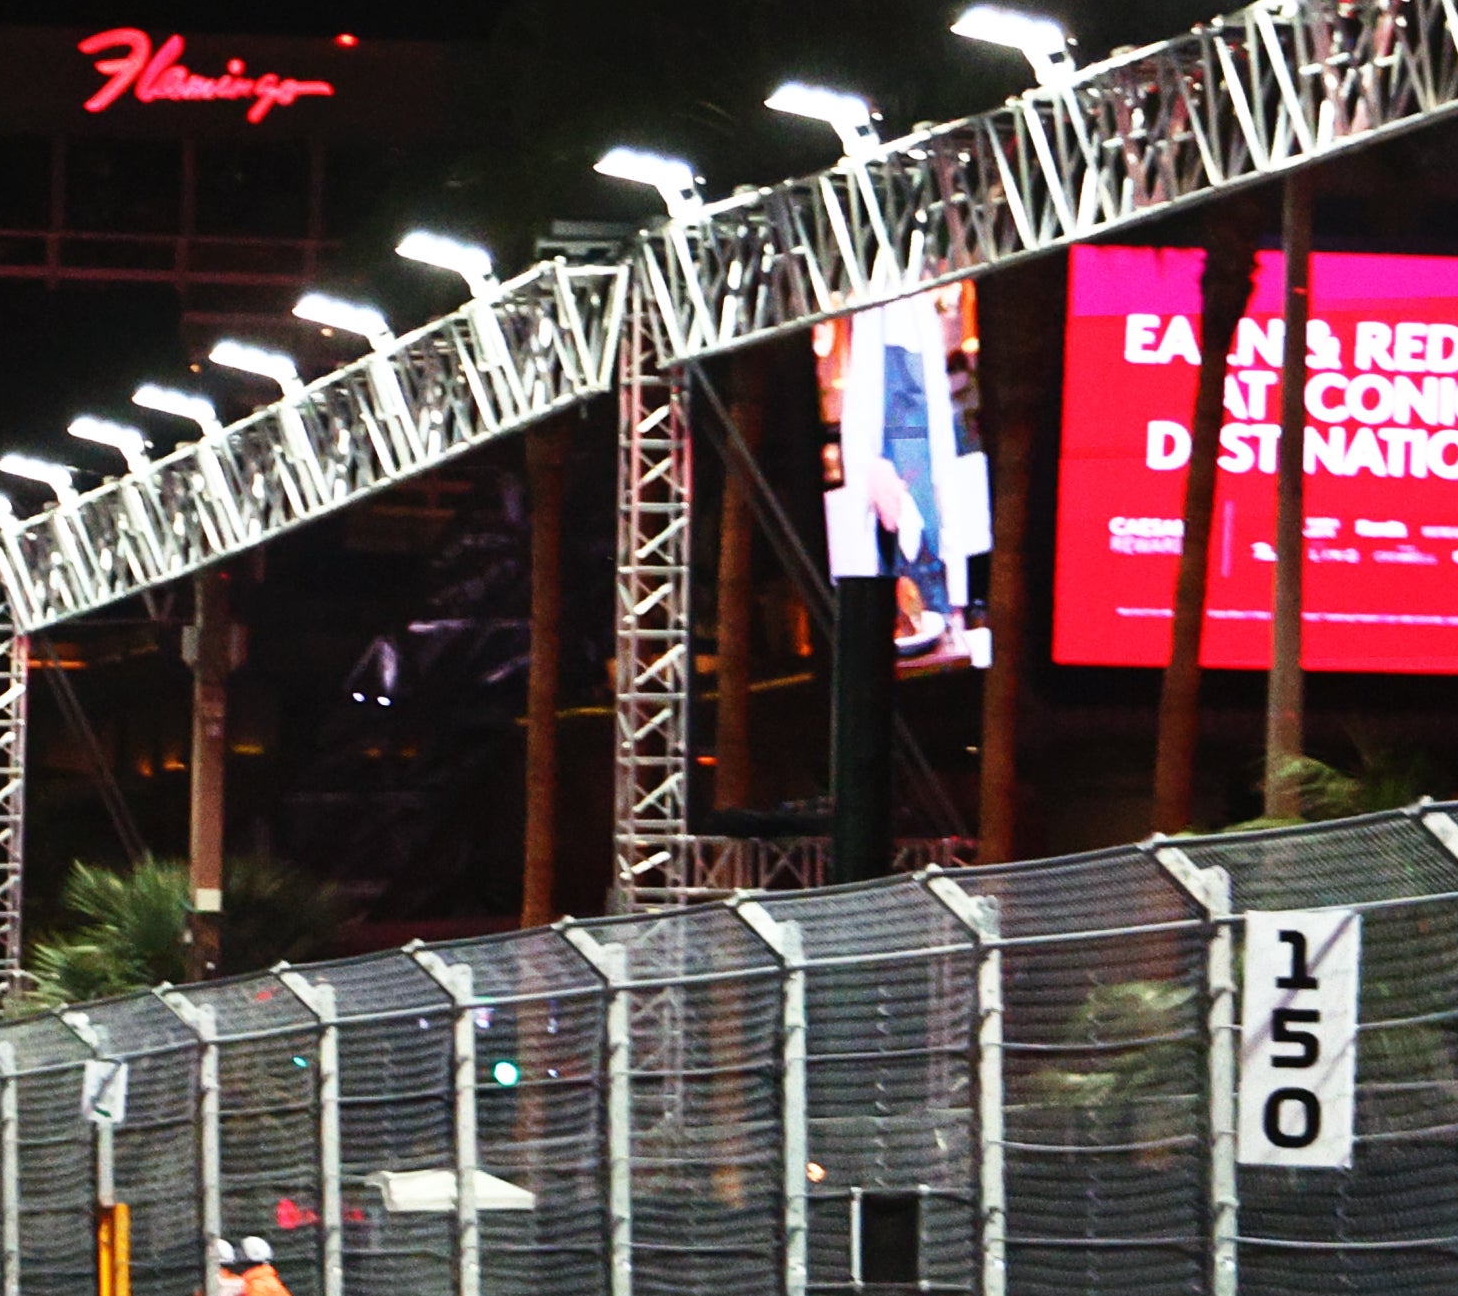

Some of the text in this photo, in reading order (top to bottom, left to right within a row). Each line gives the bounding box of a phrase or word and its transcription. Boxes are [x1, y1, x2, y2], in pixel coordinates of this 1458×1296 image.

[77, 25, 334, 124] Flamingo
[1124, 313, 1286, 367] EAN
[1263, 929, 1322, 1149] 150
